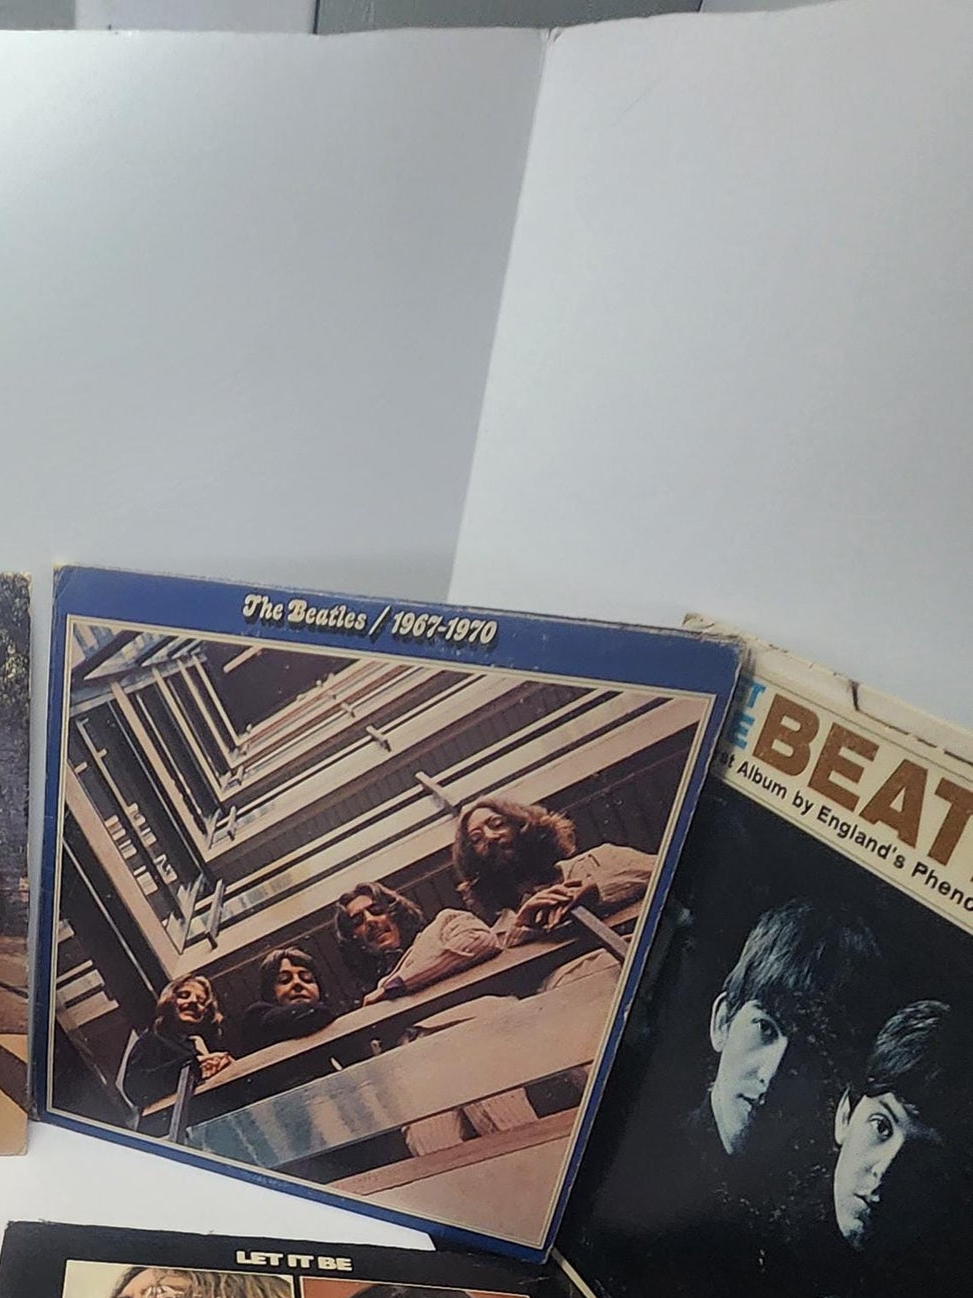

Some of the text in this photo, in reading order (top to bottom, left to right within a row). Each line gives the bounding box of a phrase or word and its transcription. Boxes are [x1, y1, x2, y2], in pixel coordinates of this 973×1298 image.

[243, 594, 282, 620] The
[288, 599, 367, 631] Beatles
[391, 611, 498, 644] 1967-1970
[737, 761, 787, 799] Album
[792, 791, 814, 816] by
[817, 805, 906, 870] England's
[751, 693, 973, 882] BEAT
[236, 1250, 353, 1272] LET IT BE
